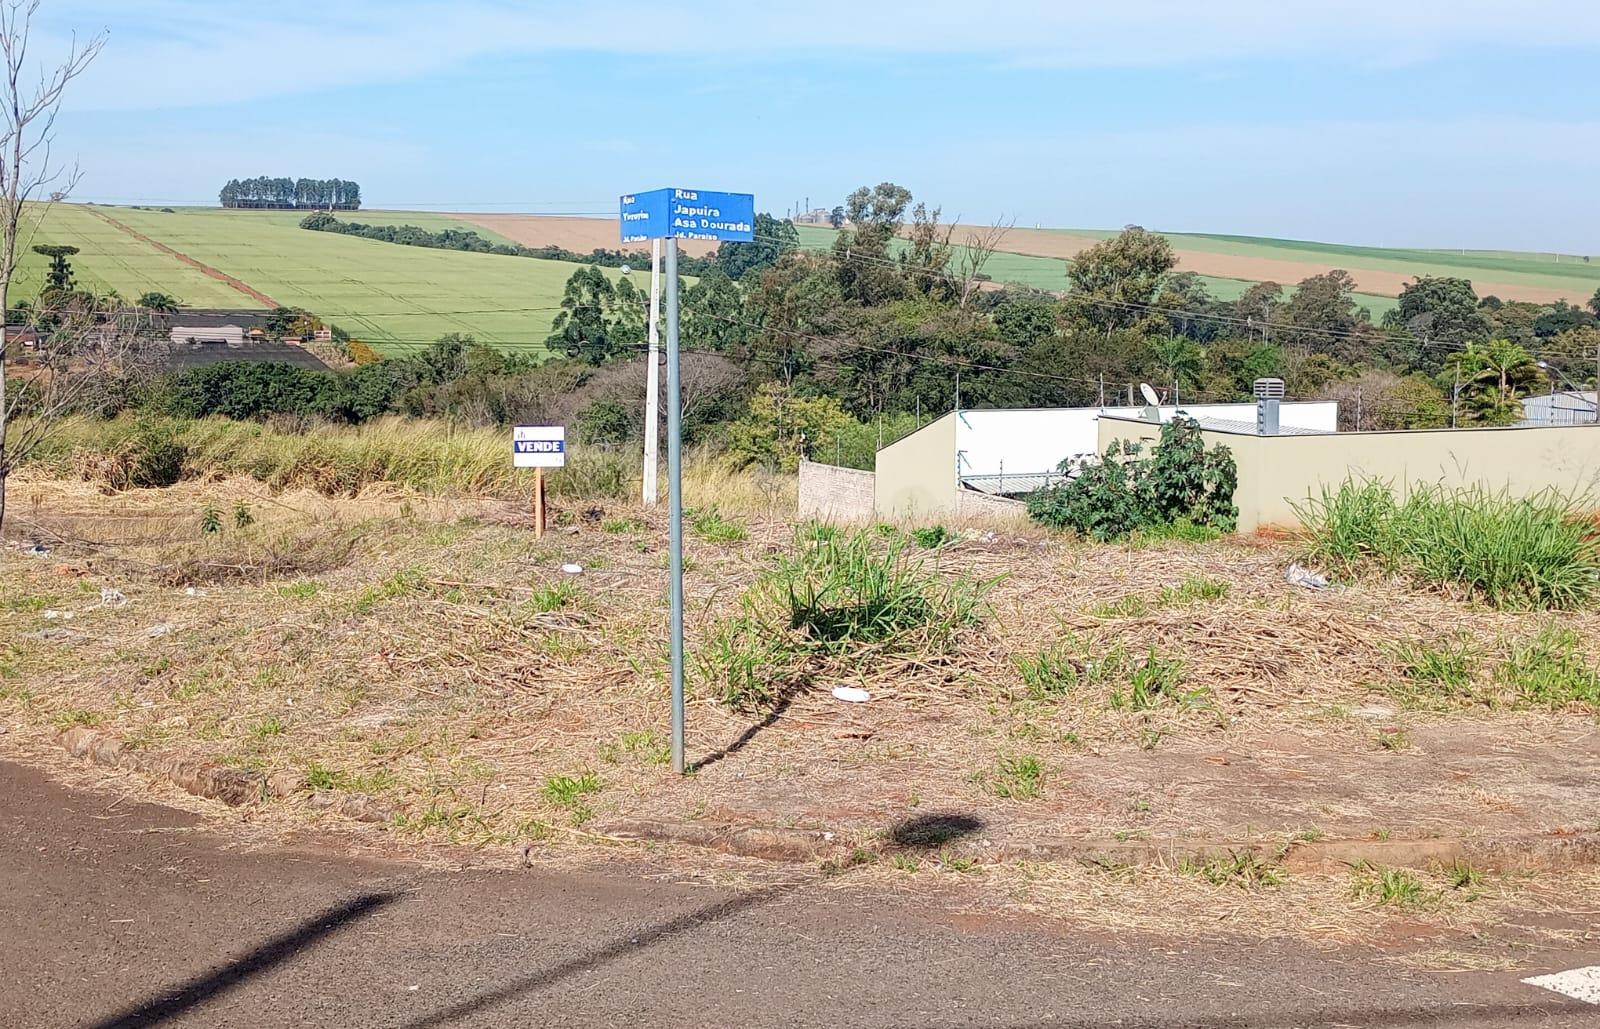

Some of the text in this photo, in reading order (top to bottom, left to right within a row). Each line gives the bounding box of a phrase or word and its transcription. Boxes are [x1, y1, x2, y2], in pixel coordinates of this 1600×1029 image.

[675, 189, 698, 200] Rua
[674, 217, 751, 232] Asa Dourada
[517, 441, 561, 452] VENDE
